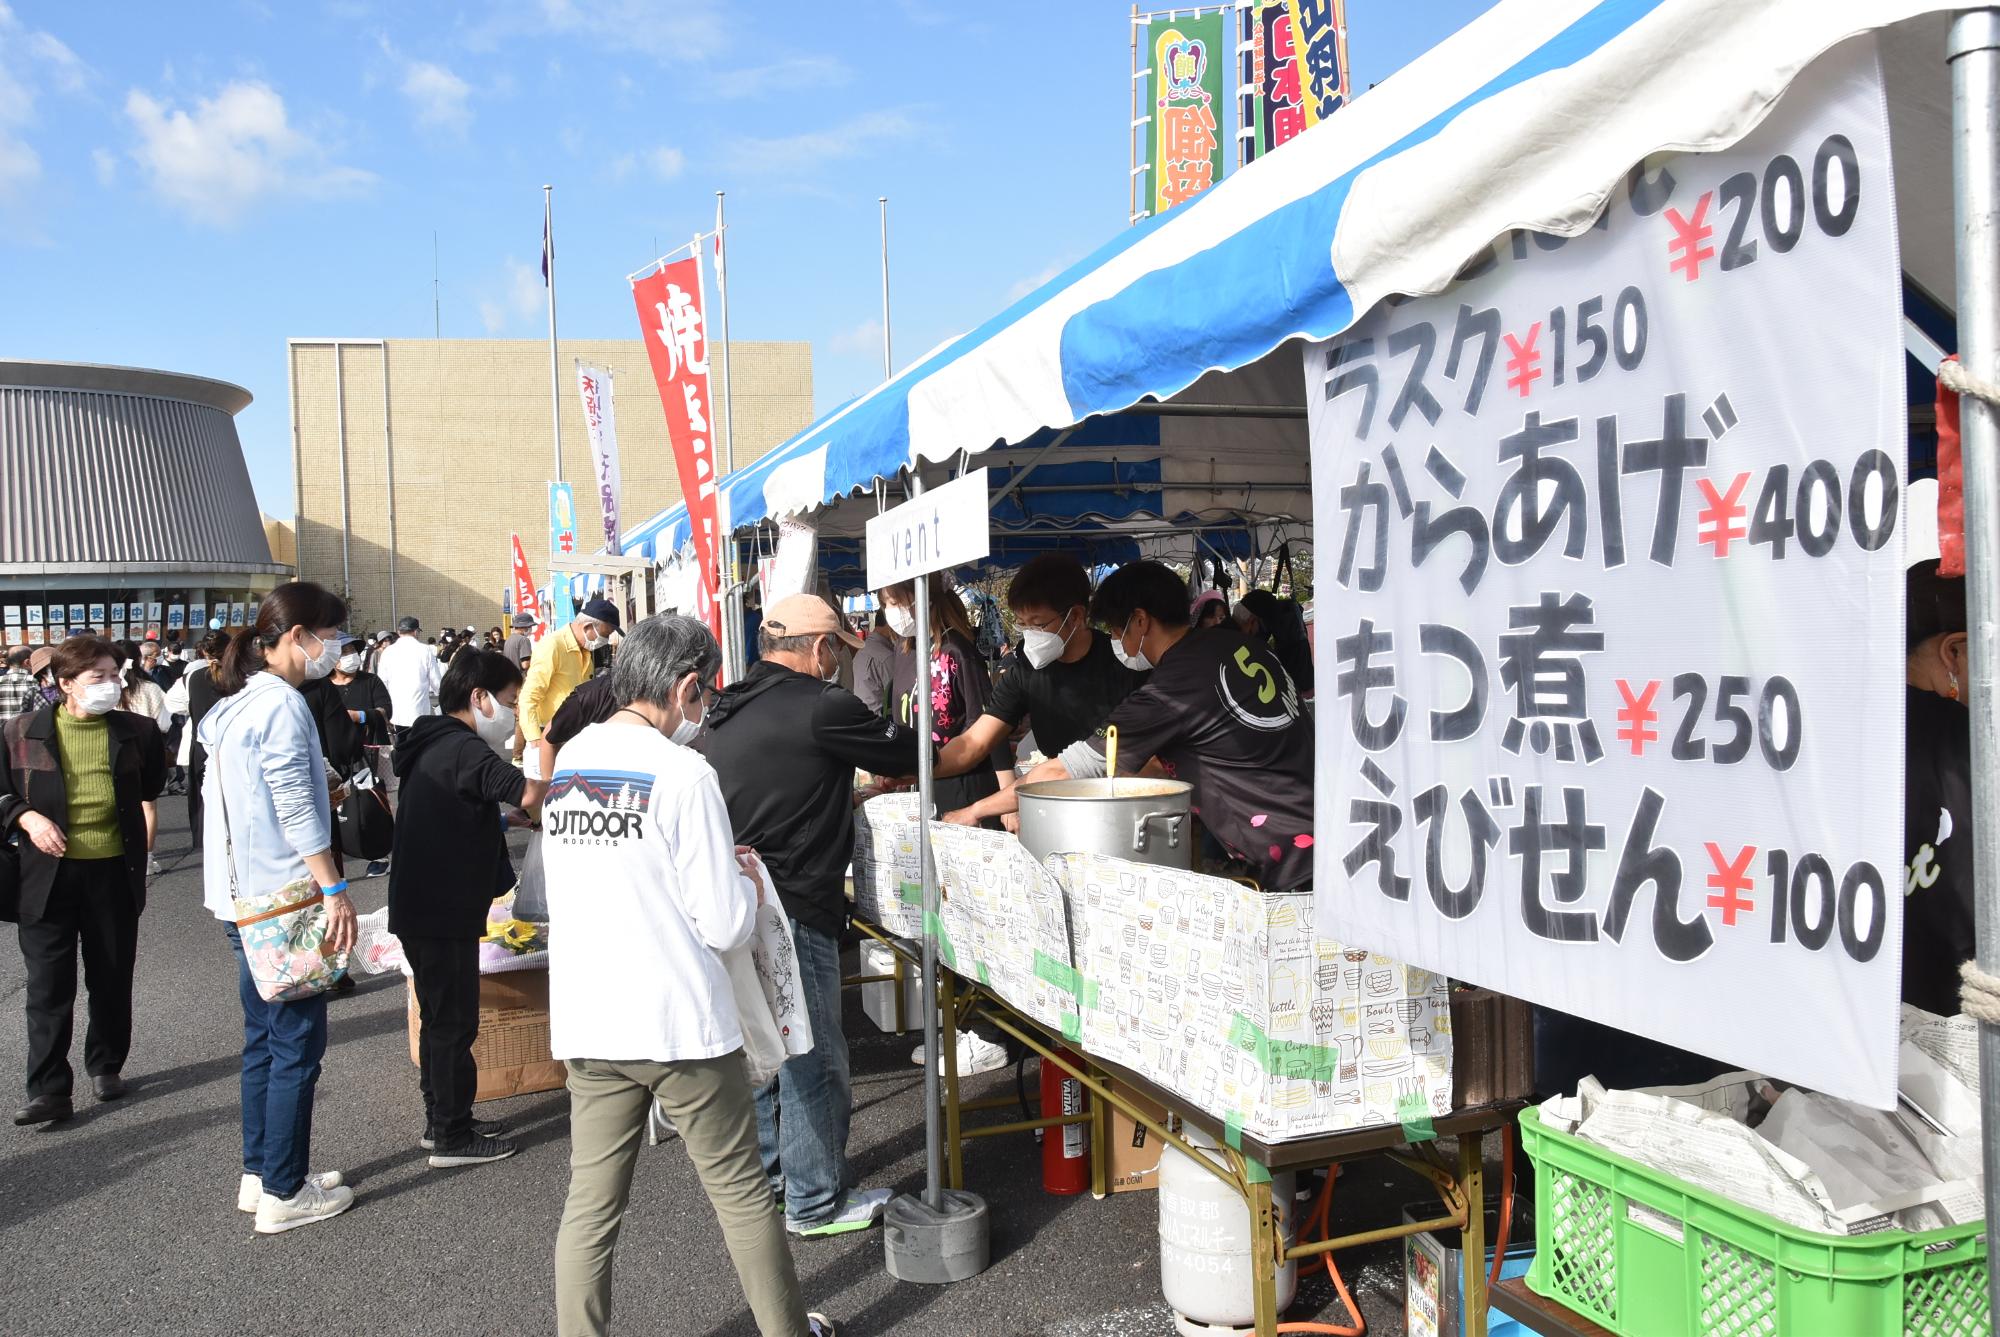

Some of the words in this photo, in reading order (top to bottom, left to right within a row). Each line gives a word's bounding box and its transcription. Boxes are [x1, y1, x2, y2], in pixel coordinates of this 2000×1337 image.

[1663, 134, 1861, 282] ¥200
[1325, 305, 1501, 440] ラスク
[1502, 285, 1649, 398] ¥150
[1336, 391, 1740, 597] からあげ
[1695, 448, 1898, 560] ¥400
[891, 508, 942, 571] vent
[1336, 591, 1605, 764] もつ煮
[1614, 671, 1802, 772] ¥250
[563, 838, 618, 847] RODUCTS
[1341, 757, 1715, 964] えびせん
[1702, 842, 1887, 963] ¥100
[1366, 1003, 1393, 1018] Bowls
[1284, 1042, 1309, 1055] Cups
[1062, 1080, 1072, 1116] YAMAT
[1255, 1110, 1279, 1127] Plates
